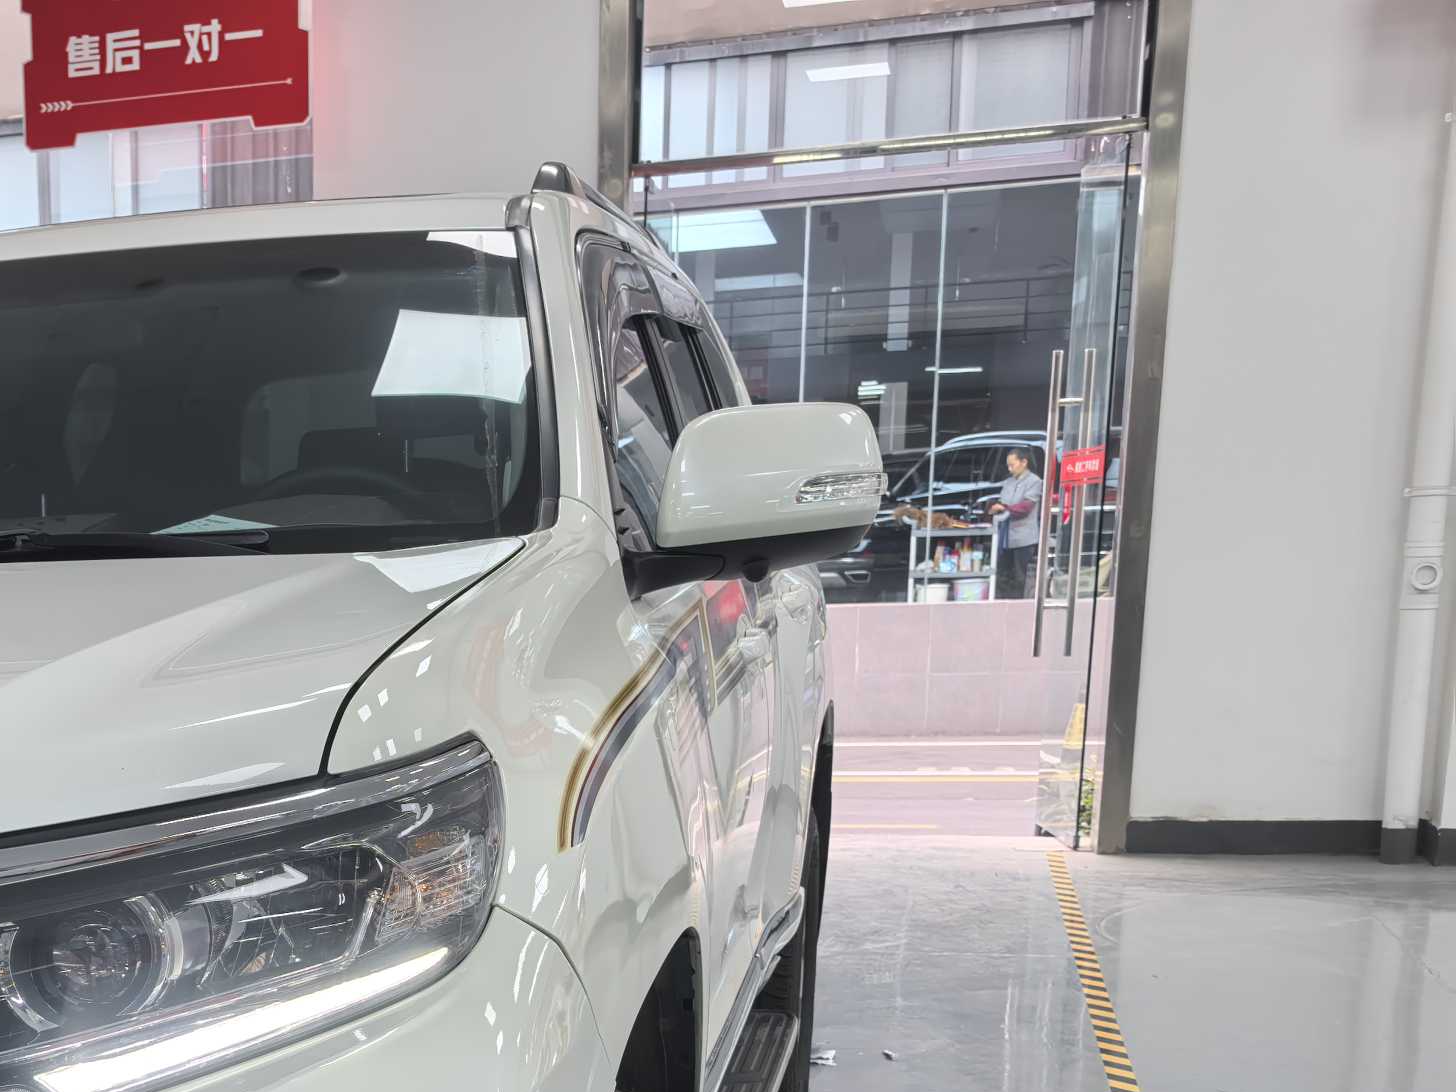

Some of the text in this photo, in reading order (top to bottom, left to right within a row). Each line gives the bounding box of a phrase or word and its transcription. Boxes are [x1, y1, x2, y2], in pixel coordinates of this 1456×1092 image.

[65, 18, 264, 78] 售后一对一
